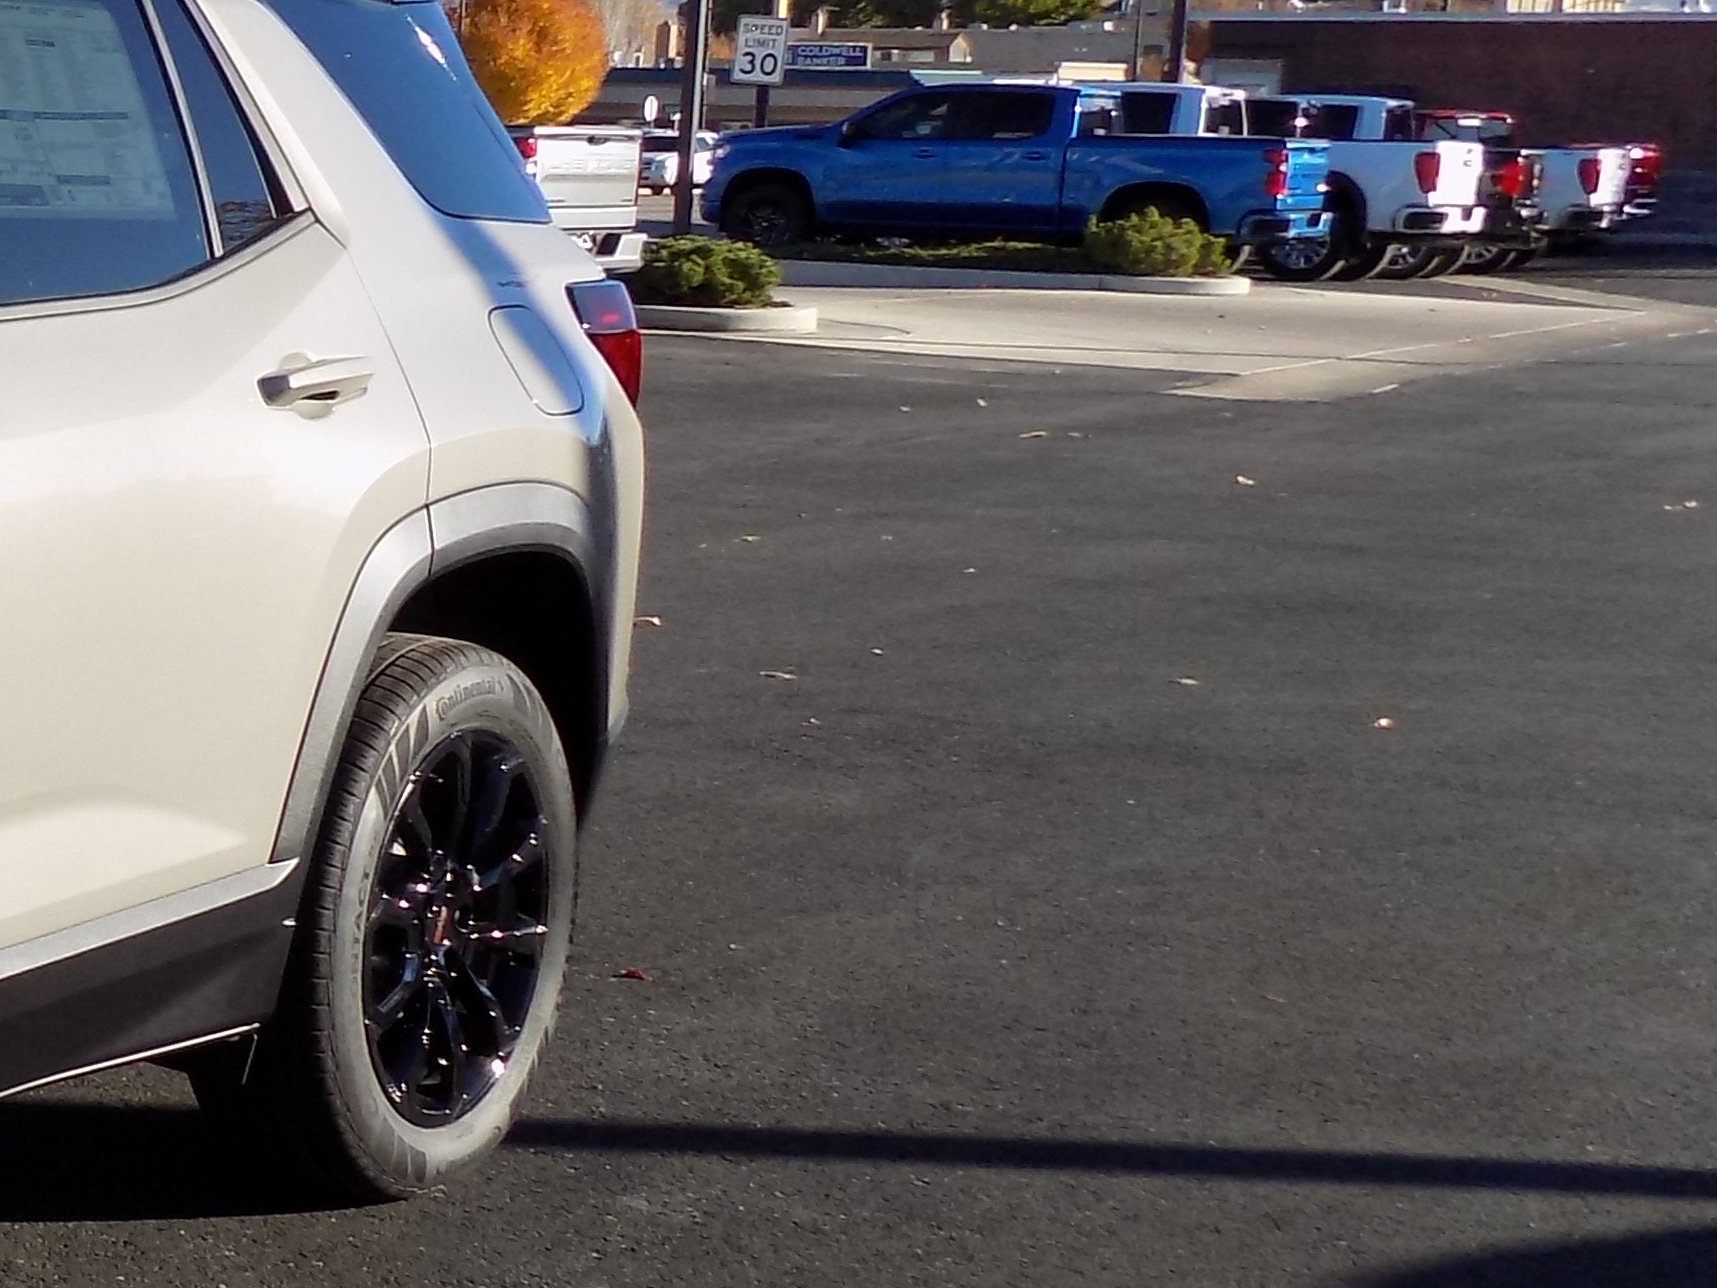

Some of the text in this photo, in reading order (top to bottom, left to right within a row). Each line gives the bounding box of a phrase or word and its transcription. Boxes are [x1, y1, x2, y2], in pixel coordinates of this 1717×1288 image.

[742, 23, 784, 36] SPEED
[744, 38, 777, 49] LIMIT
[797, 46, 864, 56] COLDWELL
[739, 52, 778, 76] 30
